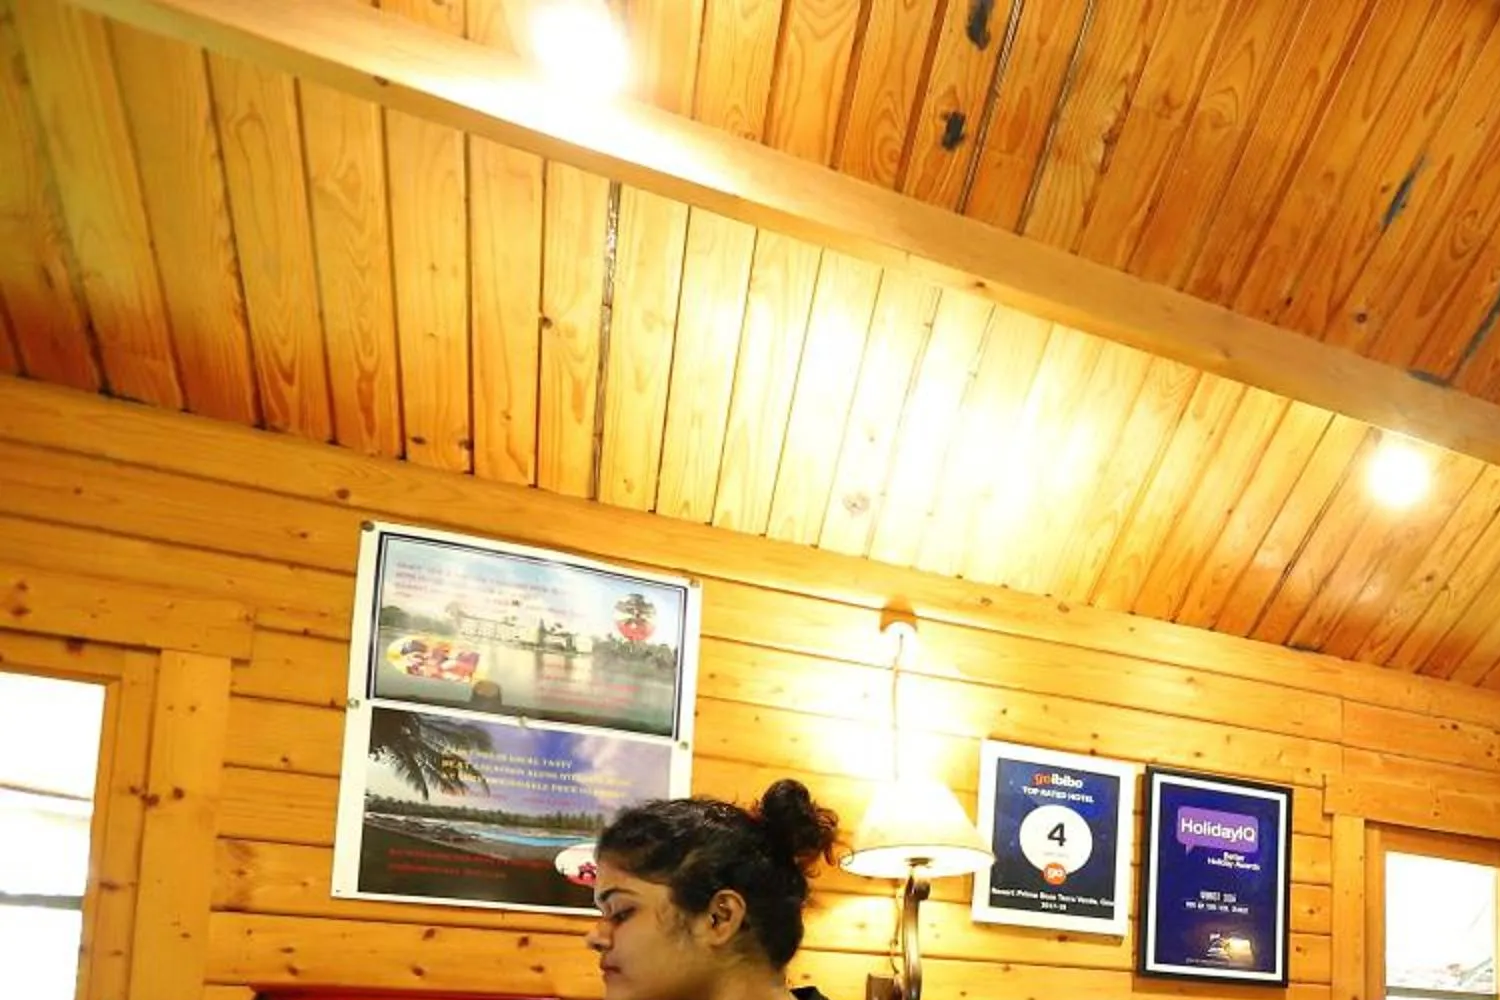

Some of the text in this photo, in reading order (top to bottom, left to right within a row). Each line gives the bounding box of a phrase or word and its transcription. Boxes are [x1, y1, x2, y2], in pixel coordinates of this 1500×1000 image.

[1023, 786, 1039, 796] TOP
[1033, 772, 1083, 789] goibibo
[1047, 822, 1066, 847] 4
[1181, 817, 1255, 842] HolidayIQ
